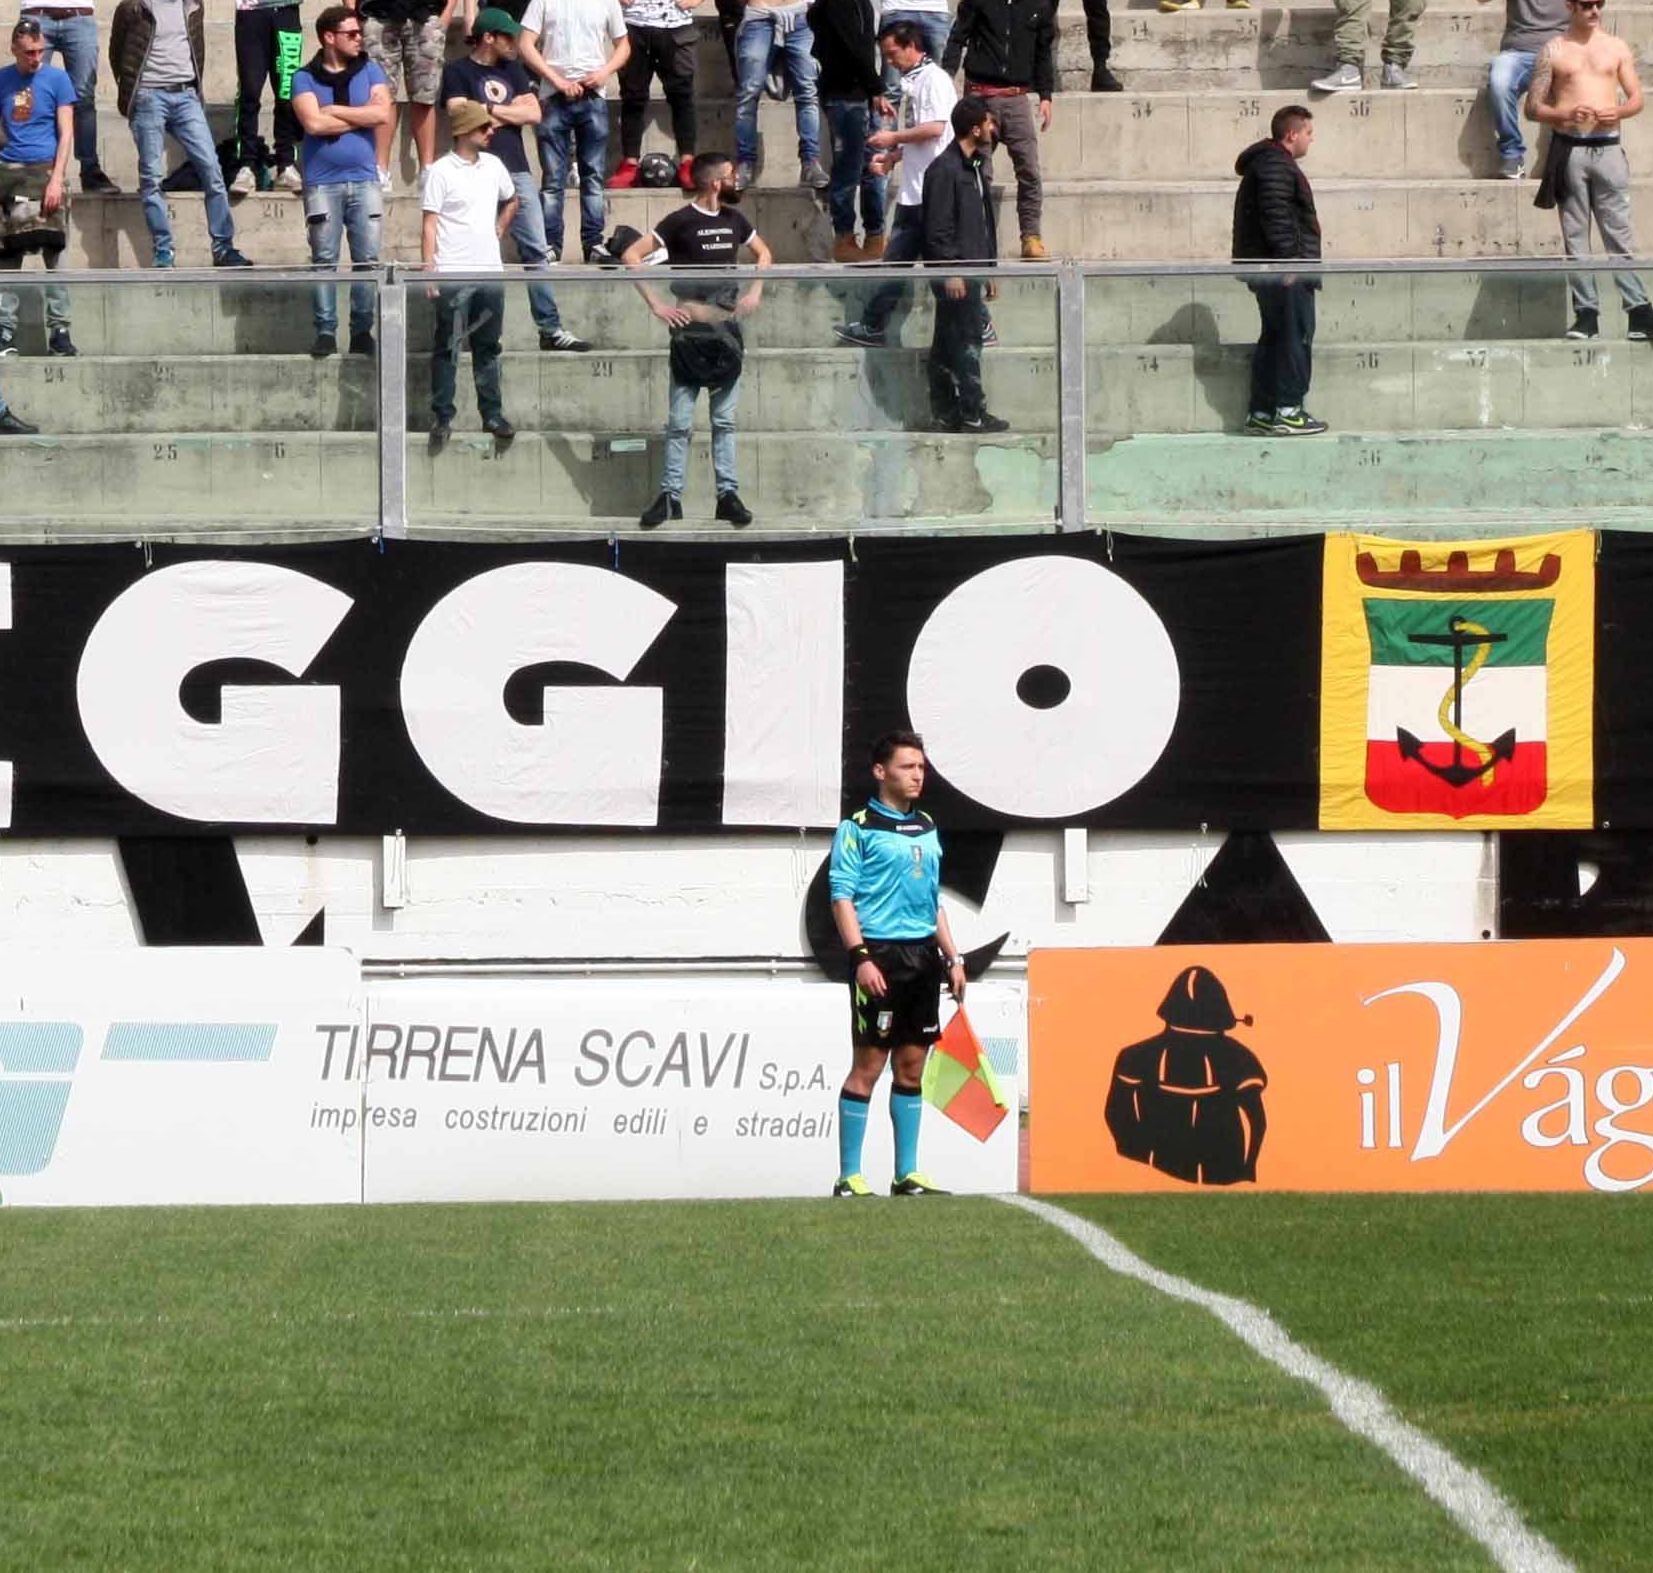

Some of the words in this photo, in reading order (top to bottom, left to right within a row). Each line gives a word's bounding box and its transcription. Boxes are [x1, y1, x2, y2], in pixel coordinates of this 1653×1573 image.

[1132, 101, 1153, 118] 34
[1239, 100, 1260, 116] 35
[1136, 356, 1159, 372] 34
[43, 366, 66, 383] 24
[153, 444, 177, 460] 25
[315, 1024, 548, 1085] TIRRENA
[574, 1029, 750, 1088] SCAVI
[759, 1063, 833, 1096] S.p.A.
[1357, 1060, 1403, 1150] il
[310, 1102, 418, 1135] impresa
[444, 1105, 588, 1132] costruzioni
[612, 1108, 667, 1135] edili
[693, 1116, 708, 1136] e
[735, 1112, 833, 1139] stradali
